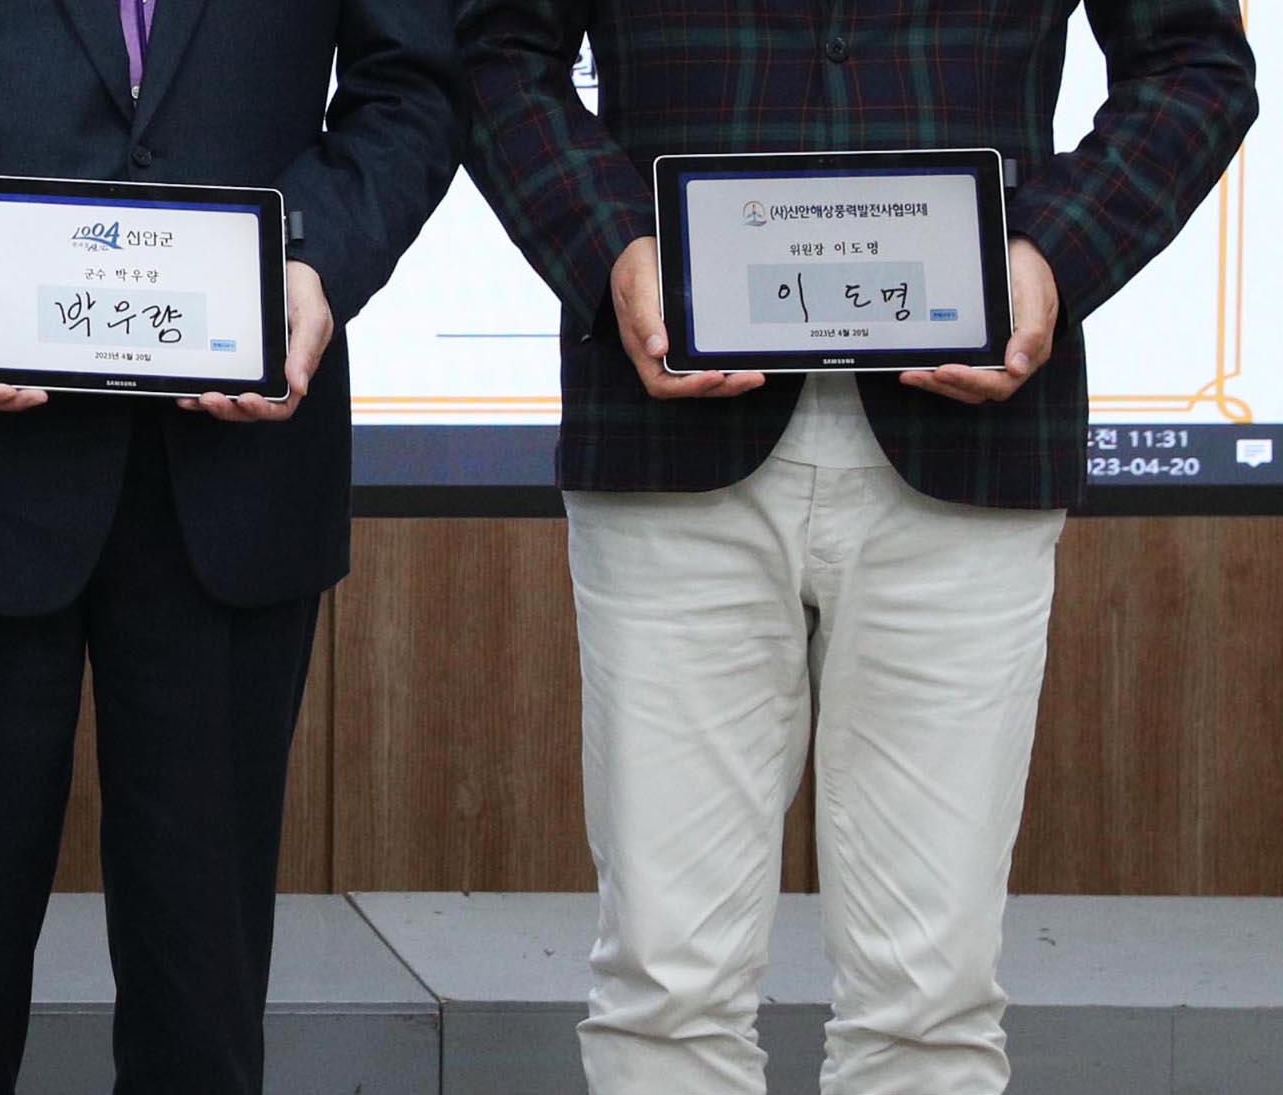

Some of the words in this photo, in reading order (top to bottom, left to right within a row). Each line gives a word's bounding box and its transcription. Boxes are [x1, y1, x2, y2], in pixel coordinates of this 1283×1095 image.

[769, 202, 929, 220] (사)신안해상풍력발전사협의체
[126, 230, 174, 247] 신안군
[789, 242, 825, 256] 위원장
[84, 268, 107, 281] 군수
[1128, 429, 1189, 448] 11:31
